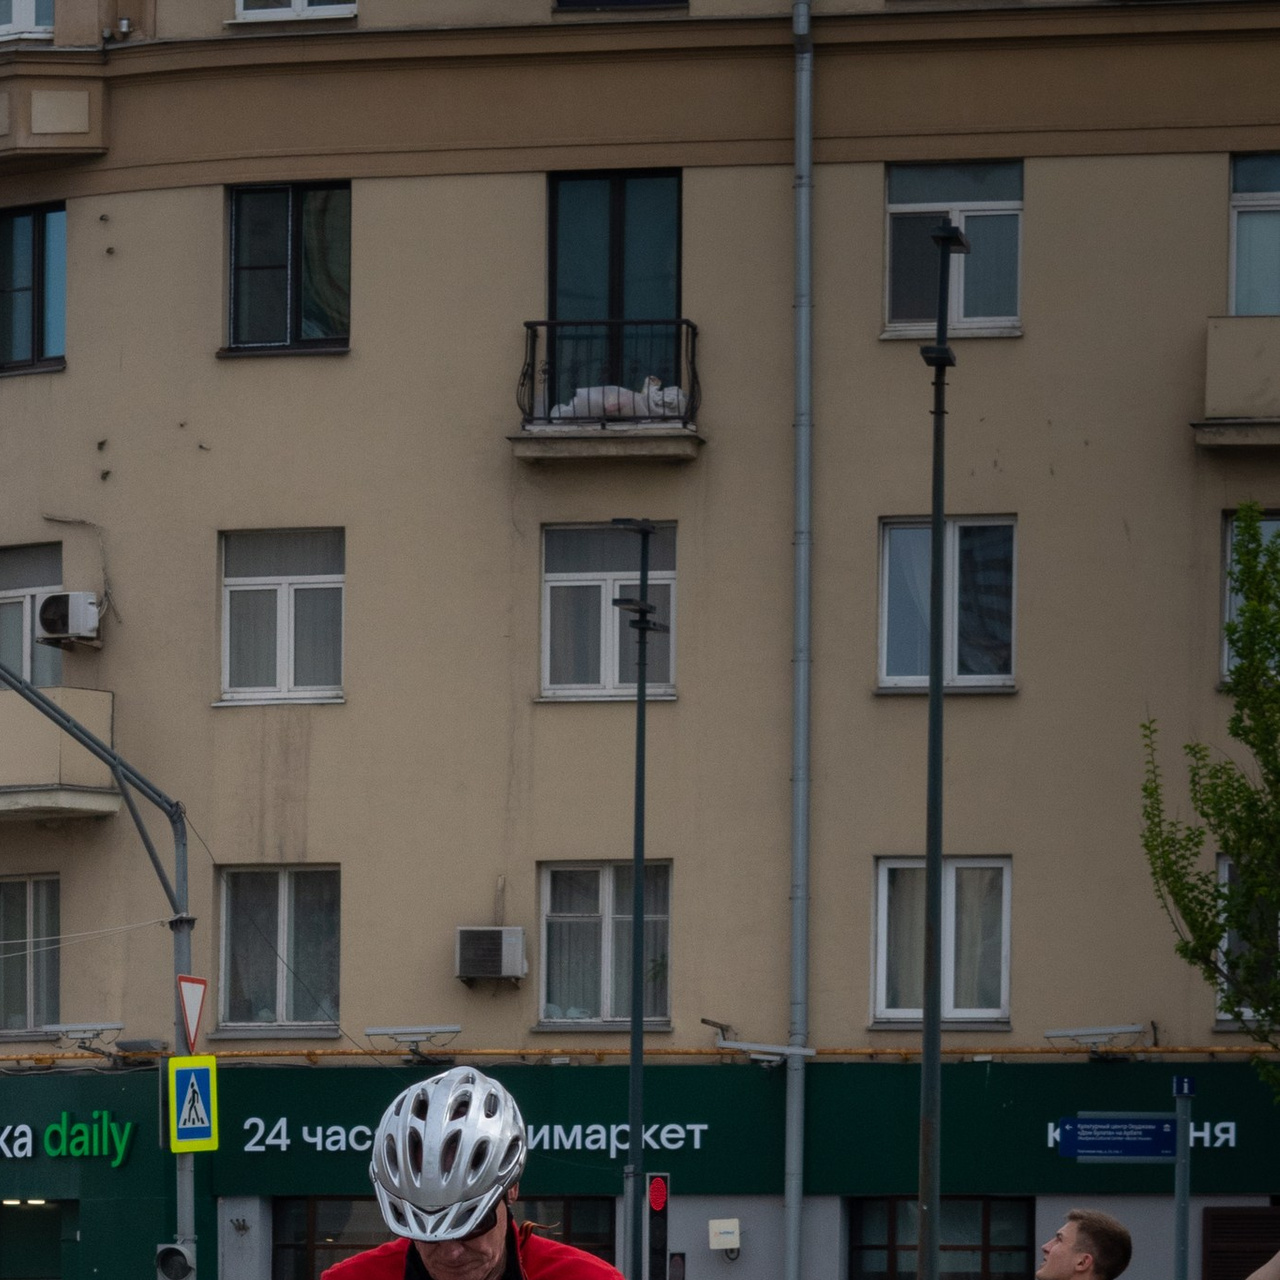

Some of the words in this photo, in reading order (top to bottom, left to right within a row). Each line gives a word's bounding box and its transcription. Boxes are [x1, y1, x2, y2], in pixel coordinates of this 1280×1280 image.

[43, 1110, 132, 1168] daily
[242, 1117, 291, 1152] 24
[302, 1126, 378, 1152] час
